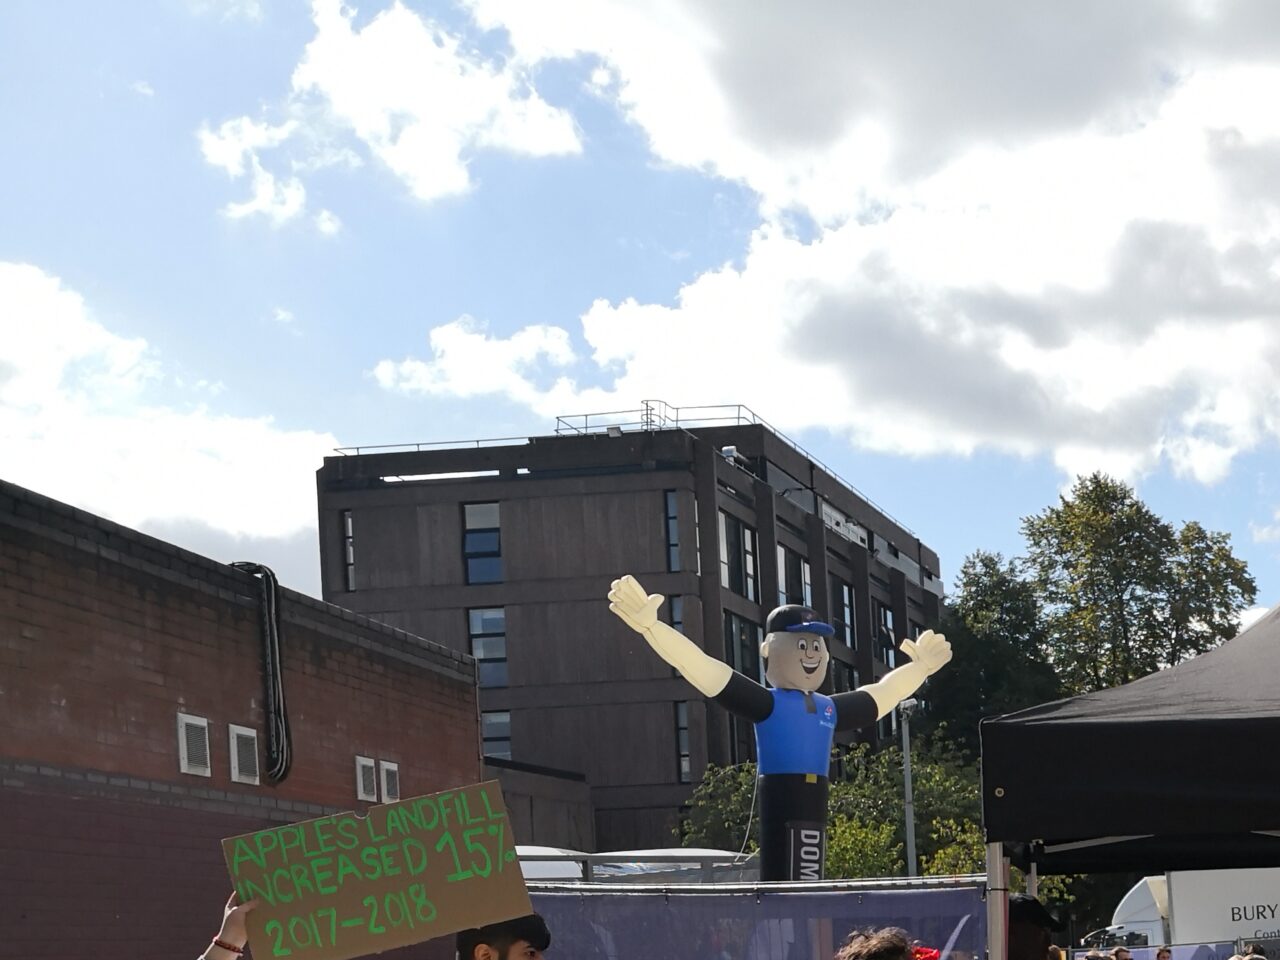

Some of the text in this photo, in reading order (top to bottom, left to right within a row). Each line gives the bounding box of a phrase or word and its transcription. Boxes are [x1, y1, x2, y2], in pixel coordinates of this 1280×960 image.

[232, 789, 506, 877] APPLE'S LANDFILL
[235, 823, 516, 907] INCREASED 15%
[264, 884, 437, 957] 2017-2018
[1231, 904, 1278, 922] BURY
